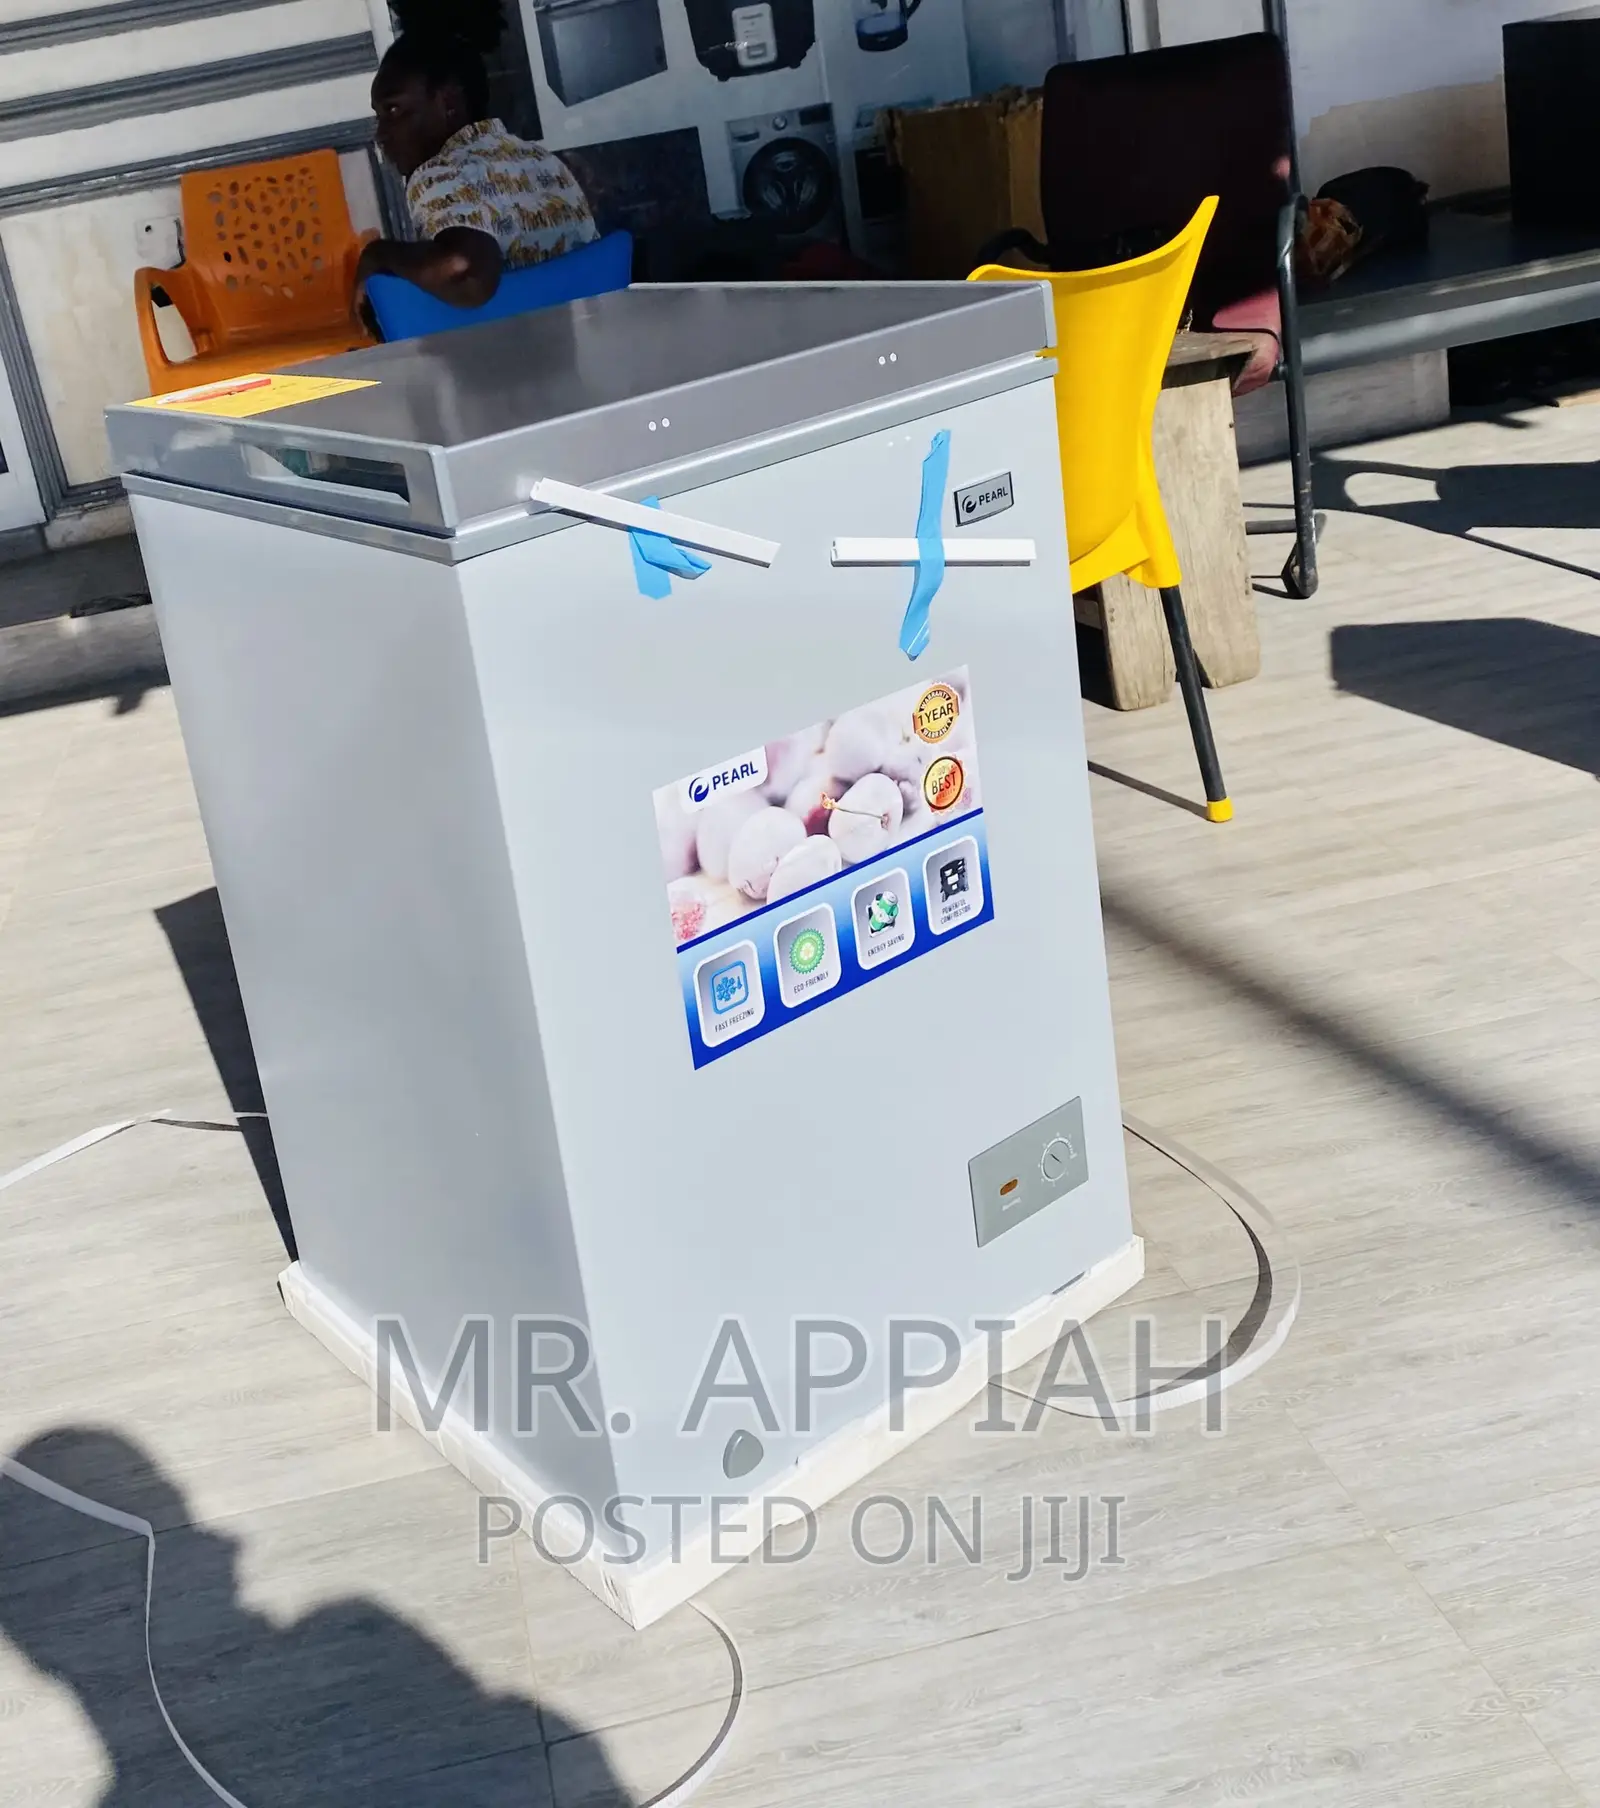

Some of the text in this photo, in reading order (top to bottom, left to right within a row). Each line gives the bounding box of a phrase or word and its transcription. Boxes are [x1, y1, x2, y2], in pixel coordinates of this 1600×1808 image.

[978, 486, 1009, 506] PEARL
[917, 702, 954, 726] 1 YEAR
[712, 760, 759, 790] PEARL
[931, 771, 956, 796] BEST
[867, 933, 905, 957] ENERGY SAVING
[793, 970, 829, 995] ECO-FRIENDLY
[714, 1007, 755, 1033] FAST FREEZING
